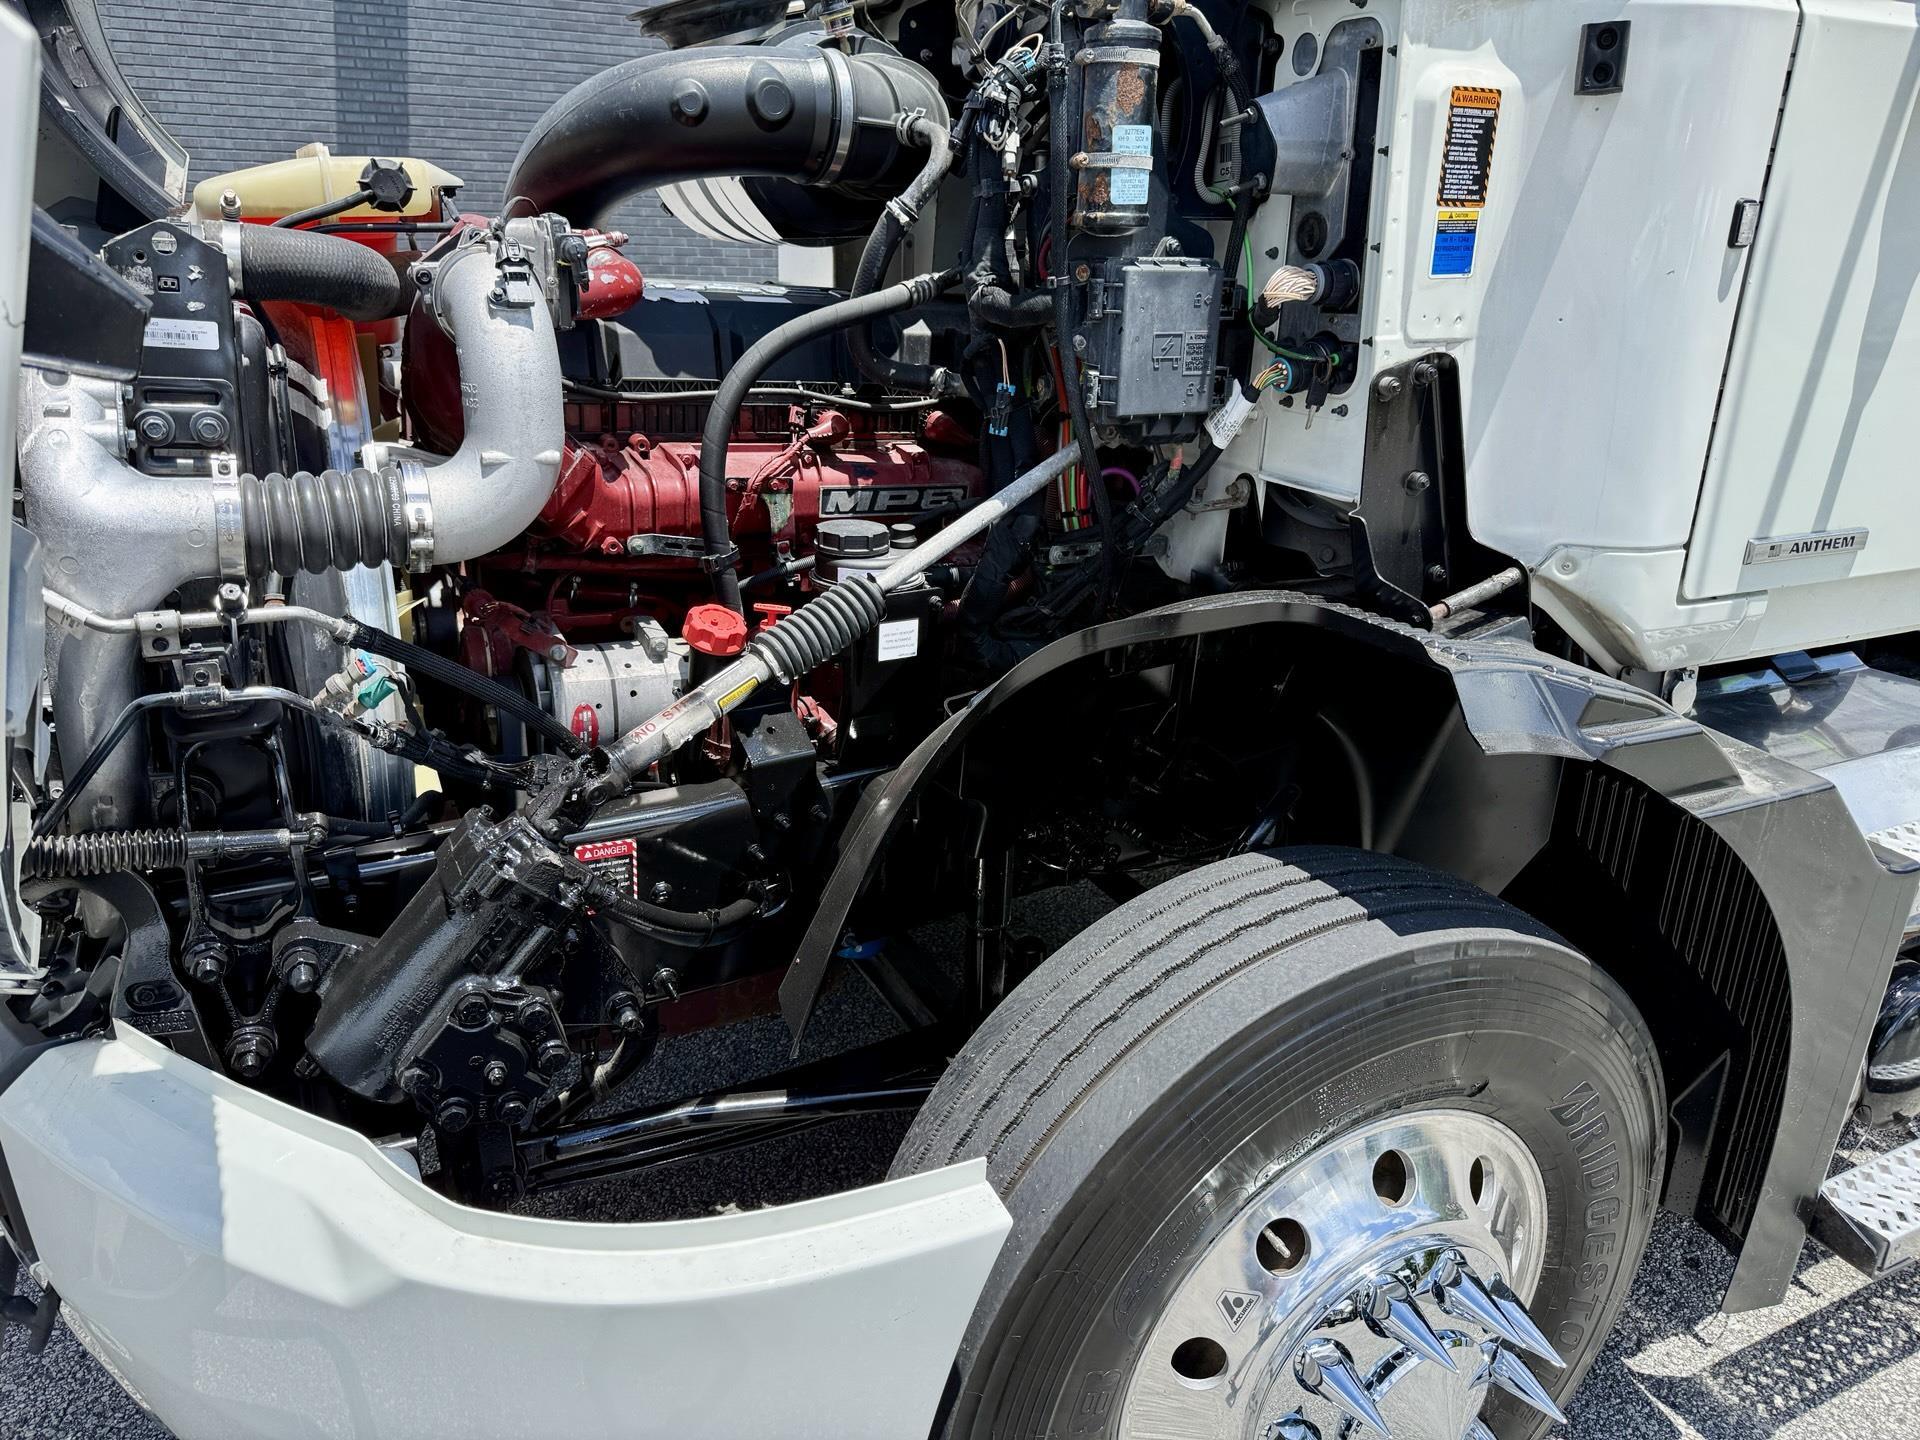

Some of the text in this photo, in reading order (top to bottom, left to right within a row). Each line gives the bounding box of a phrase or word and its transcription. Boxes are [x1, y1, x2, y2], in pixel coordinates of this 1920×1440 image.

[1462, 94, 1497, 105] WARNING
[1220, 166, 1232, 176] C5
[825, 488, 964, 512] MP8
[392, 504, 402, 526] CHINA
[1789, 536, 1856, 554] ANTHEM
[635, 722, 656, 740] NO
[594, 845, 628, 857] DANGER
[1233, 1298, 1254, 1326] ACCURIDE
